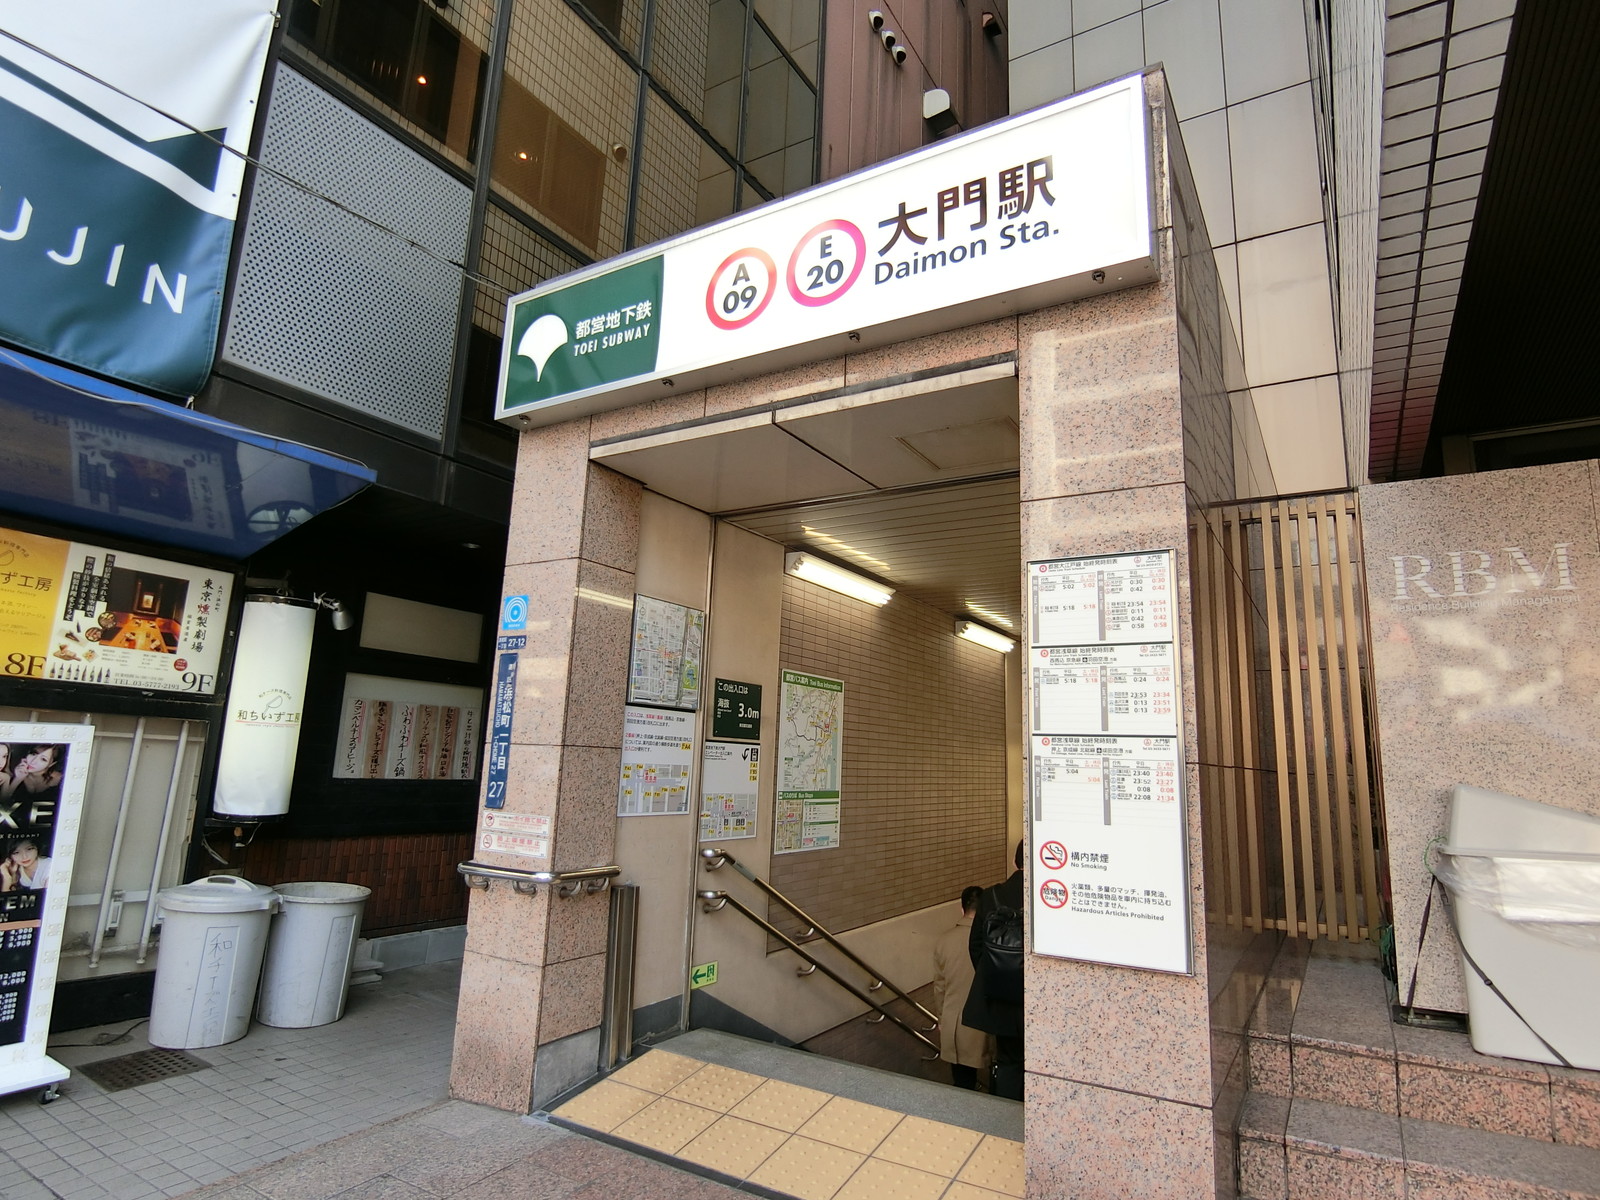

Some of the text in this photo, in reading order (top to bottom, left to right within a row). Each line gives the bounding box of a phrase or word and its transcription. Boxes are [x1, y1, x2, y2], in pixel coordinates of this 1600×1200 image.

[877, 154, 1056, 258] 大門駅
[819, 235, 832, 260] E
[874, 219, 1060, 286] Daimon Sta.
[732, 263, 751, 287] A
[806, 259, 844, 291] 20
[722, 285, 758, 314] 09
[575, 299, 652, 340] 都営地下鉄
[574, 323, 651, 357] TOEI SUBWAY
[1389, 542, 1579, 601] RBM
[1390, 602, 1449, 613] Residence
[1500, 594, 1580, 608] Management
[508, 638, 526, 648] 27-12
[4, 652, 47, 676] 8F
[181, 671, 214, 693] 9F
[718, 682, 748, 694] この出入口は
[738, 702, 760, 719] 3.0m
[394, 705, 412, 777] ふわふわチーズ鍋
[490, 764, 497, 775] 27
[488, 781, 504, 798] 27
[1070, 852, 1110, 864] 構内禁煙
[1081, 863, 1108, 871] Smoking
[1072, 898, 1128, 910] ことはできません。
[1072, 906, 1164, 921] Hazardous Articles Prohibited
